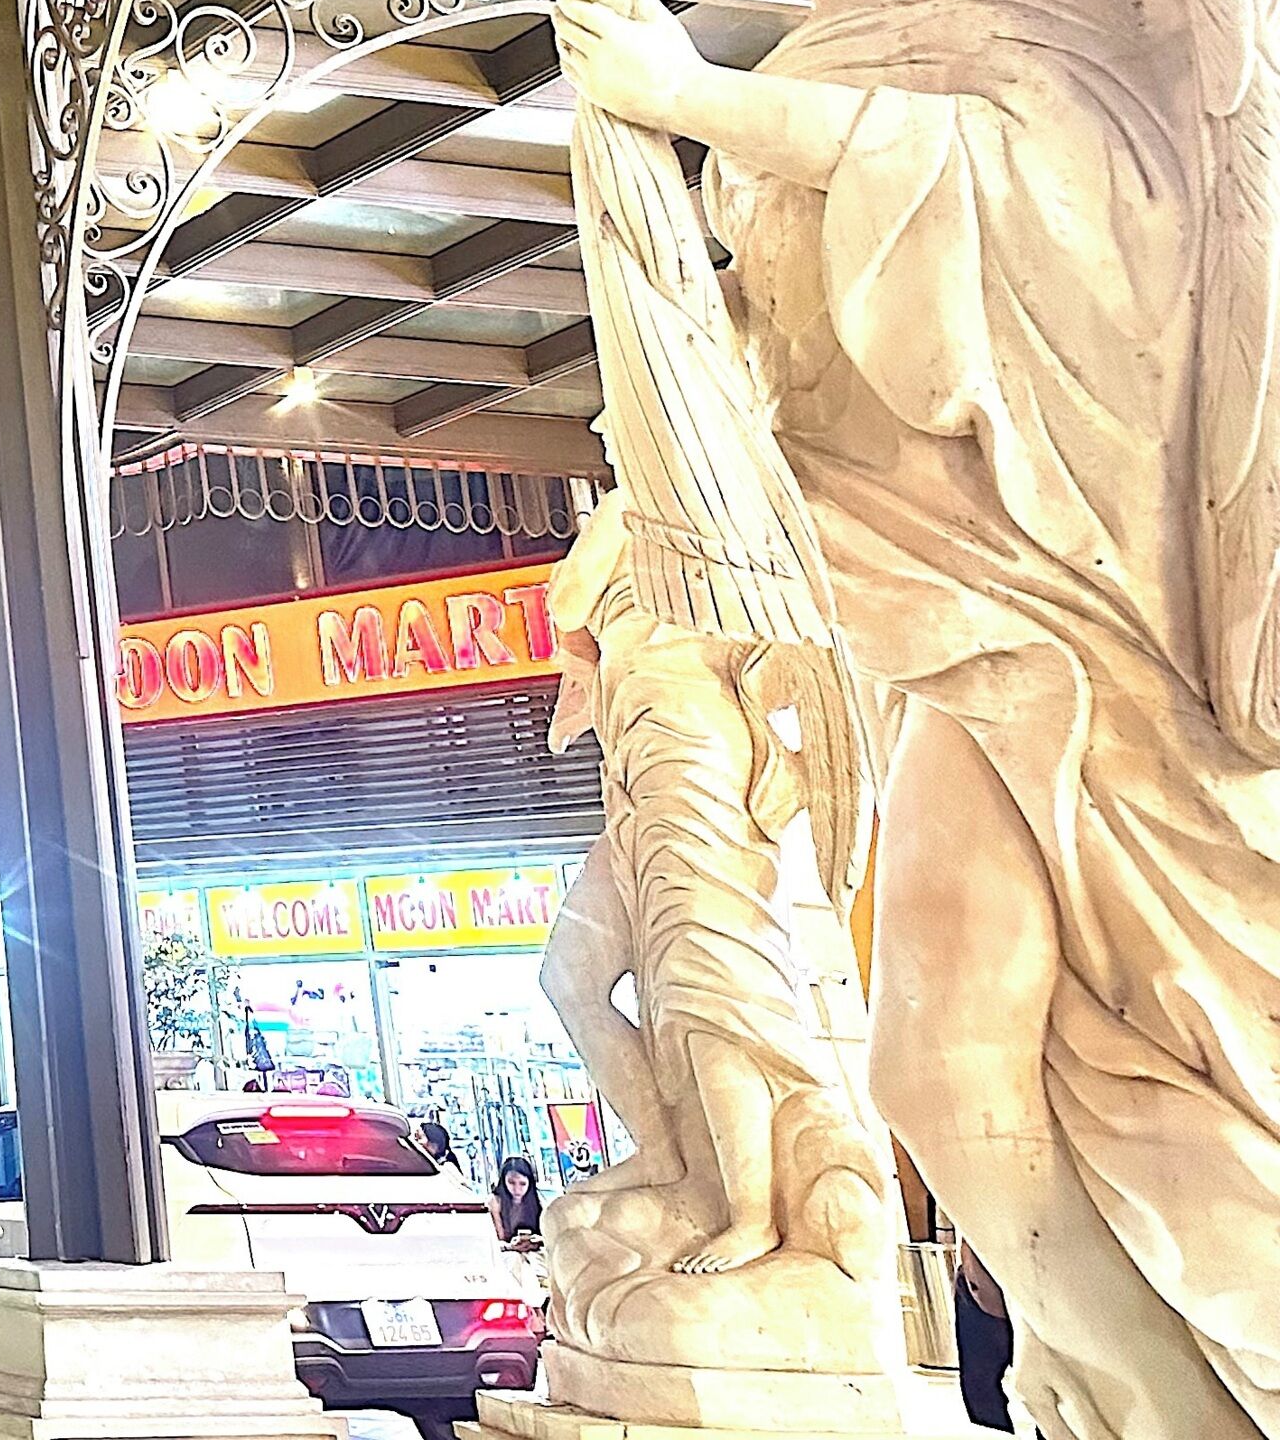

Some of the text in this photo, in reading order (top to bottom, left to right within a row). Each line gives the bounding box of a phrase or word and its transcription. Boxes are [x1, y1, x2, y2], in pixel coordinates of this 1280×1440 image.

[114, 582, 559, 710] OON MART
[471, 886, 552, 929] MART
